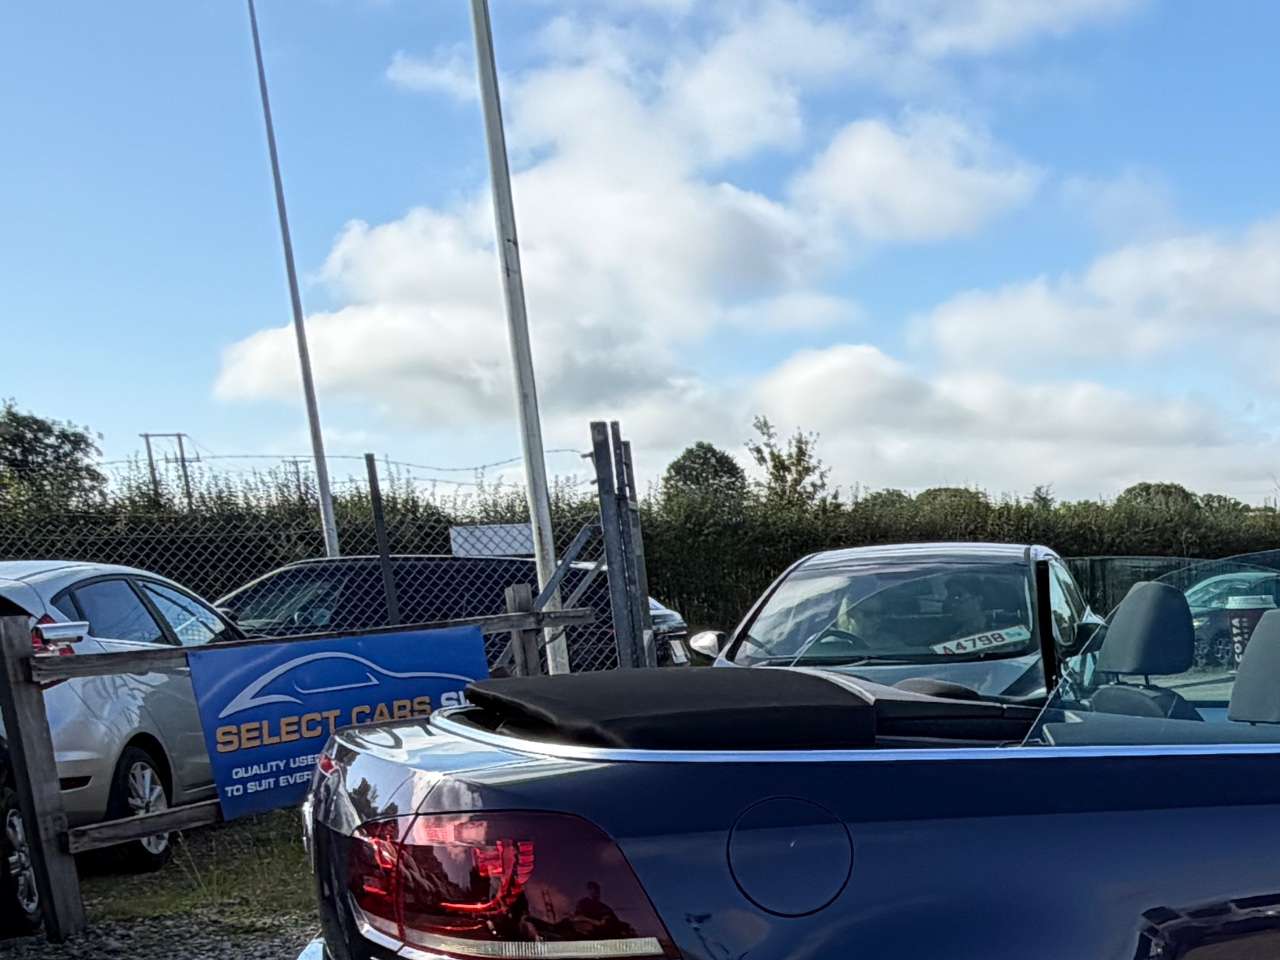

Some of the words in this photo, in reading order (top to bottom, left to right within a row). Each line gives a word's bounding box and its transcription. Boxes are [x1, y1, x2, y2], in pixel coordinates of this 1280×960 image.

[216, 709, 341, 753] SELECT
[351, 696, 431, 726] CARS
[232, 759, 287, 779] QUALITY
[225, 785, 243, 797] TO
[247, 778, 276, 793] SUIT
[280, 771, 312, 787] EVER
